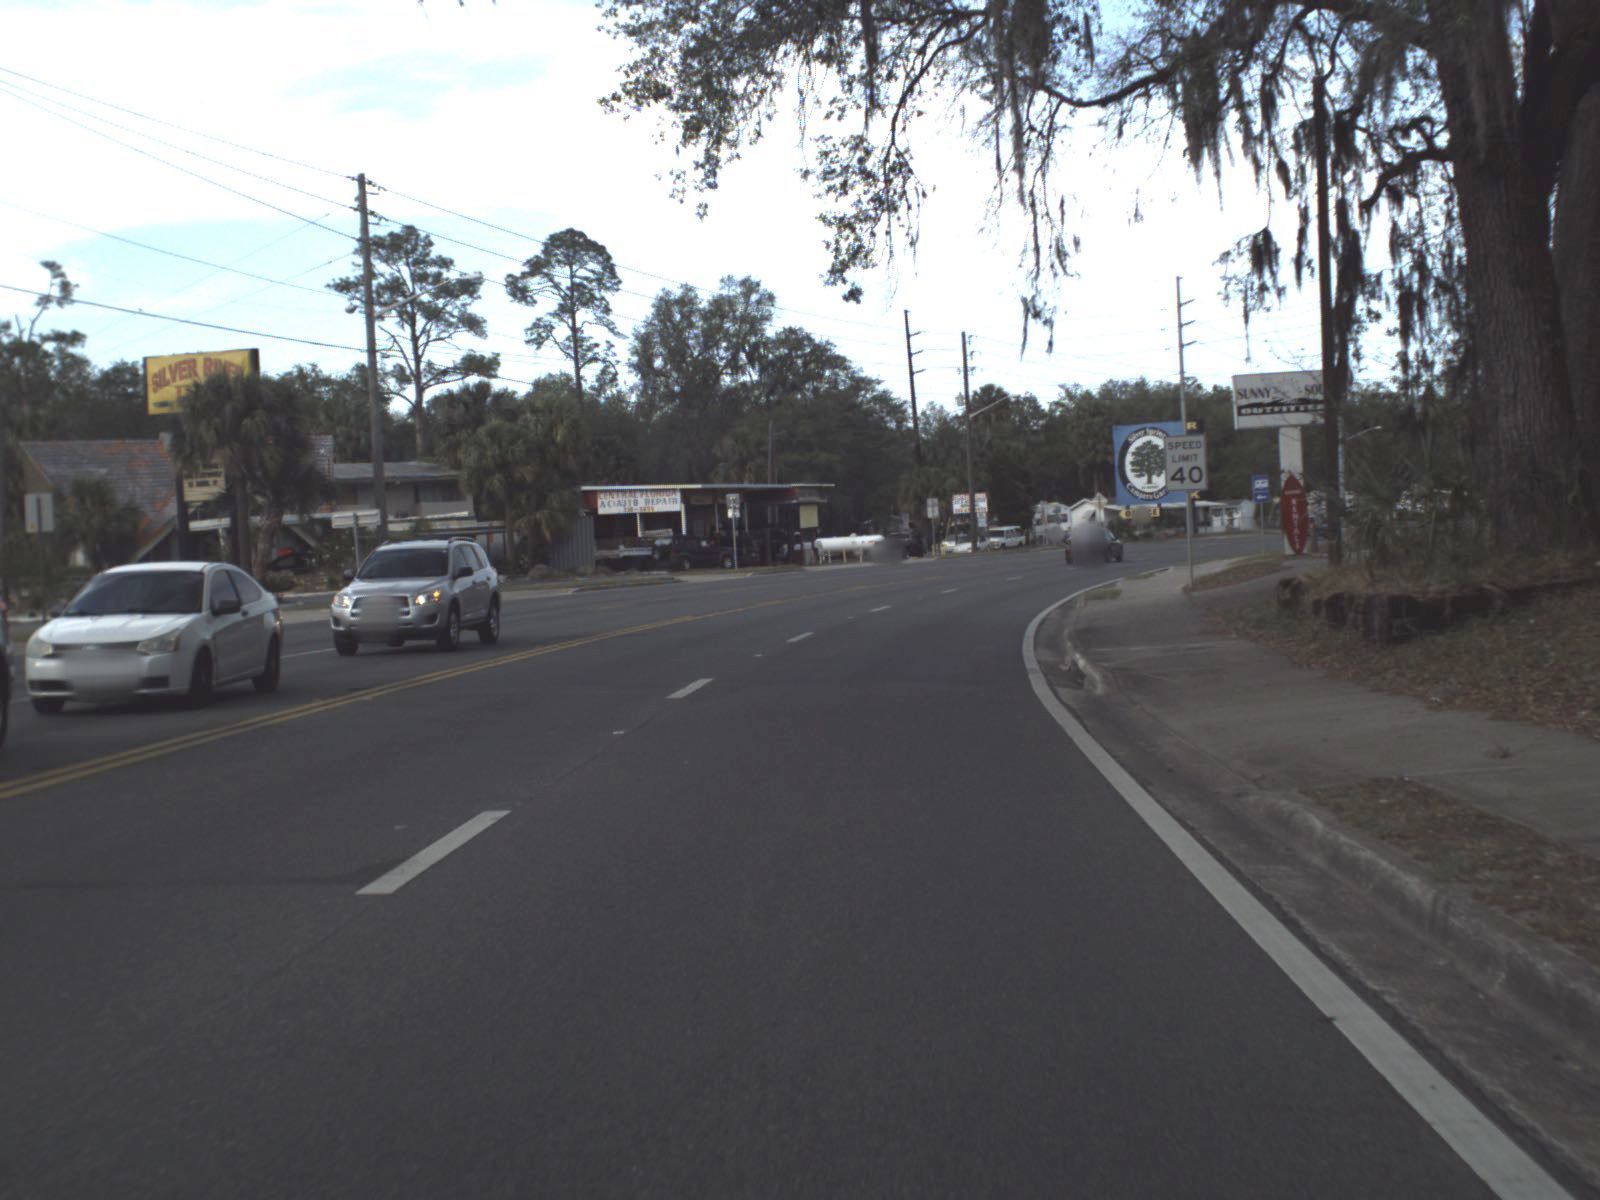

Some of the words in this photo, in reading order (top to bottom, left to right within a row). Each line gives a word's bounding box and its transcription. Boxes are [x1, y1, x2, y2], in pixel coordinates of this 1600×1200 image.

[152, 358, 200, 394] SILVER
[1236, 386, 1273, 399] SUNNY
[1303, 383, 1324, 395] SOU
[1167, 440, 1202, 450] SPEED
[1171, 453, 1199, 463] LIMIT
[1170, 466, 1203, 484] 40
[643, 498, 679, 507] REPAIR
